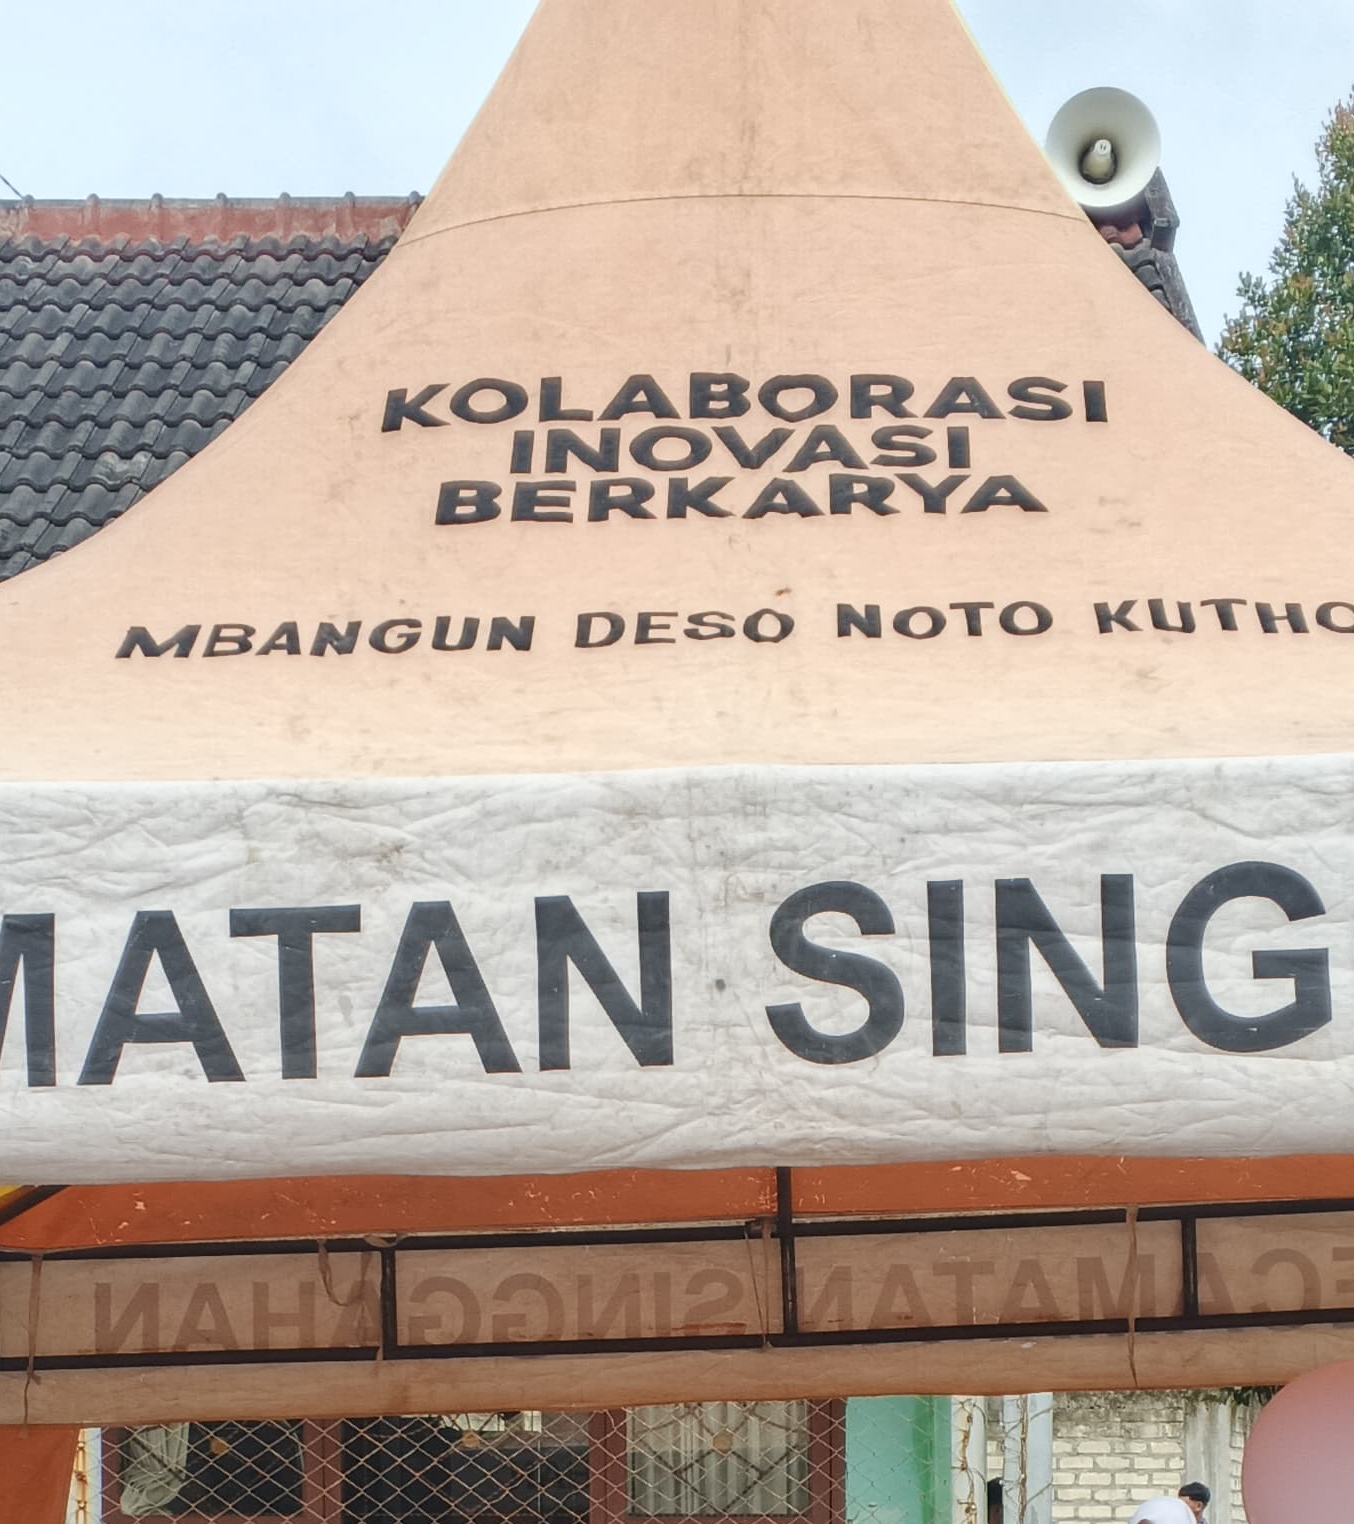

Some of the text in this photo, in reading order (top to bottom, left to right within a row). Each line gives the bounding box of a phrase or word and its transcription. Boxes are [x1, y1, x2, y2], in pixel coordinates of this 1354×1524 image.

[381, 372, 1108, 434] KOLABORASI
[510, 424, 971, 474] INOVASI
[434, 473, 1048, 526] BERKARYA
[115, 616, 536, 659] MBANGUN
[574, 608, 795, 648] DESO
[837, 601, 1053, 640] NOTO
